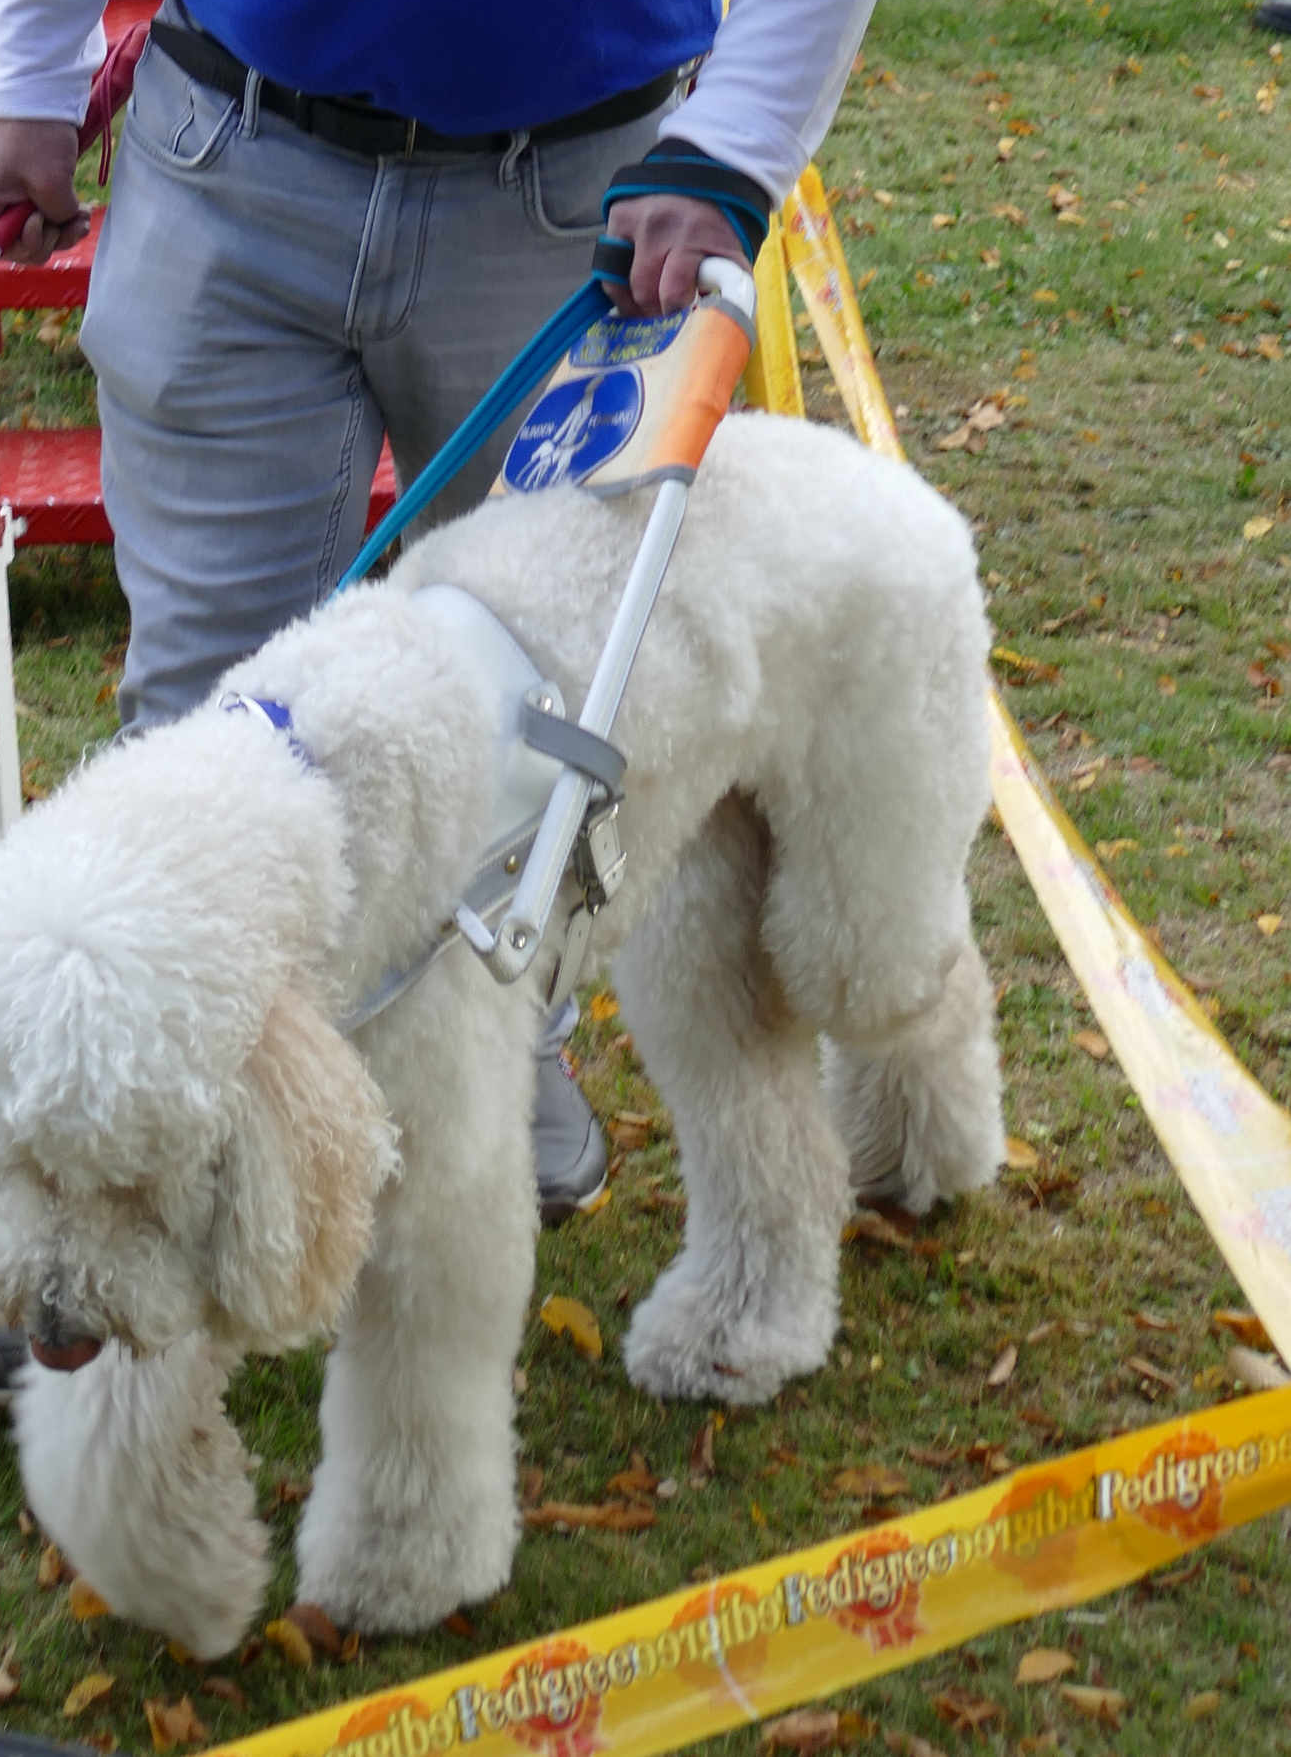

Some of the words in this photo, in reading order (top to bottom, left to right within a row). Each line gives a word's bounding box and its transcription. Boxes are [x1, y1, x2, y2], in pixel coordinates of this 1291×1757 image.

[456, 1642, 638, 1741] Pedigree
[784, 1530, 956, 1626] Pedigree
[1096, 1441, 1259, 1520] Pedigree
